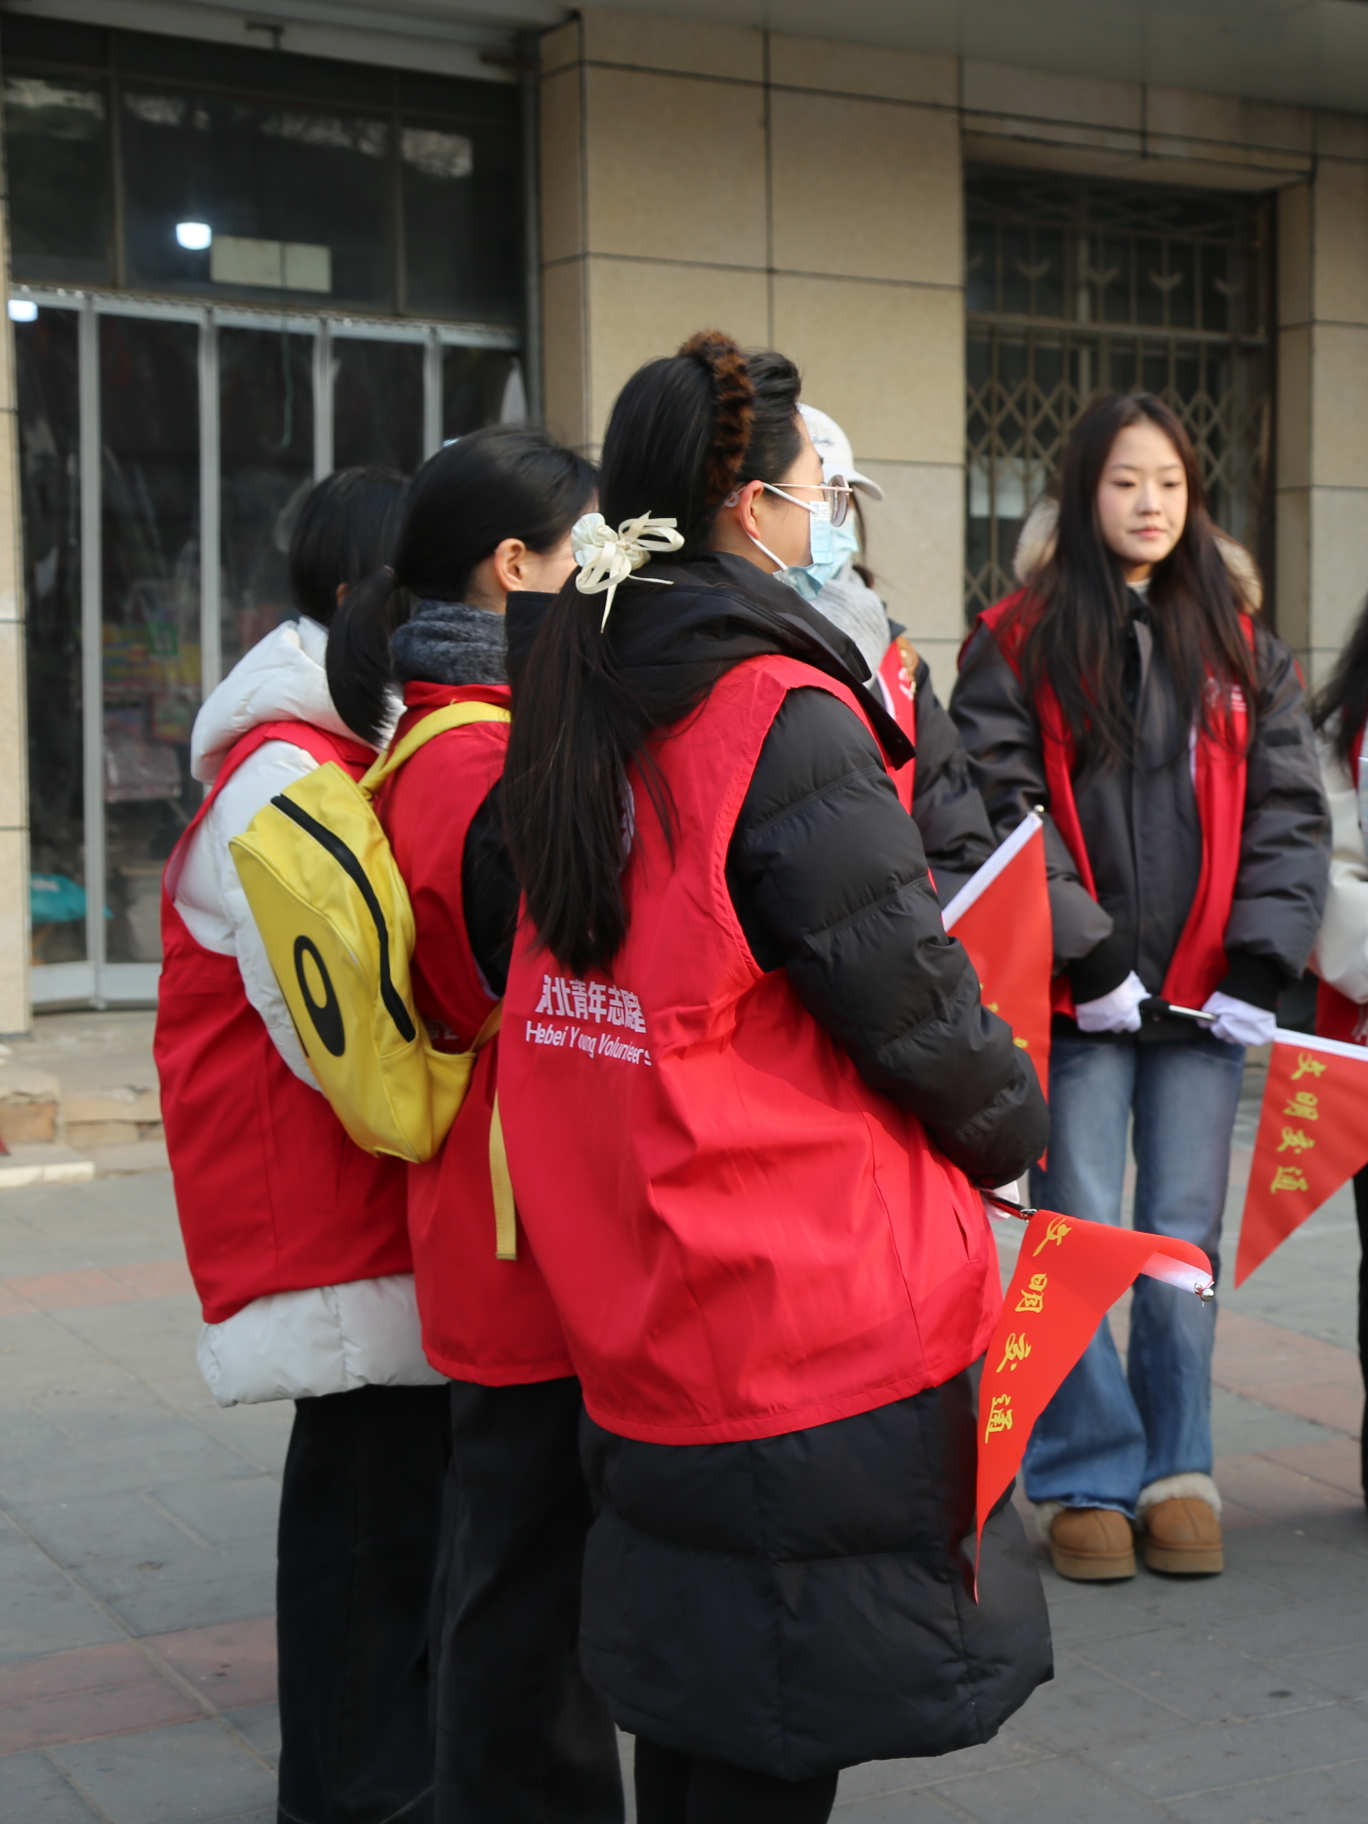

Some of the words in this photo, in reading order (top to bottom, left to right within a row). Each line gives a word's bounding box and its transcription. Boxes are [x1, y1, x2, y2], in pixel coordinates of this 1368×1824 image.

[525, 1020, 569, 1047] Hebei
[984, 1216, 1073, 1445] 文明交通
